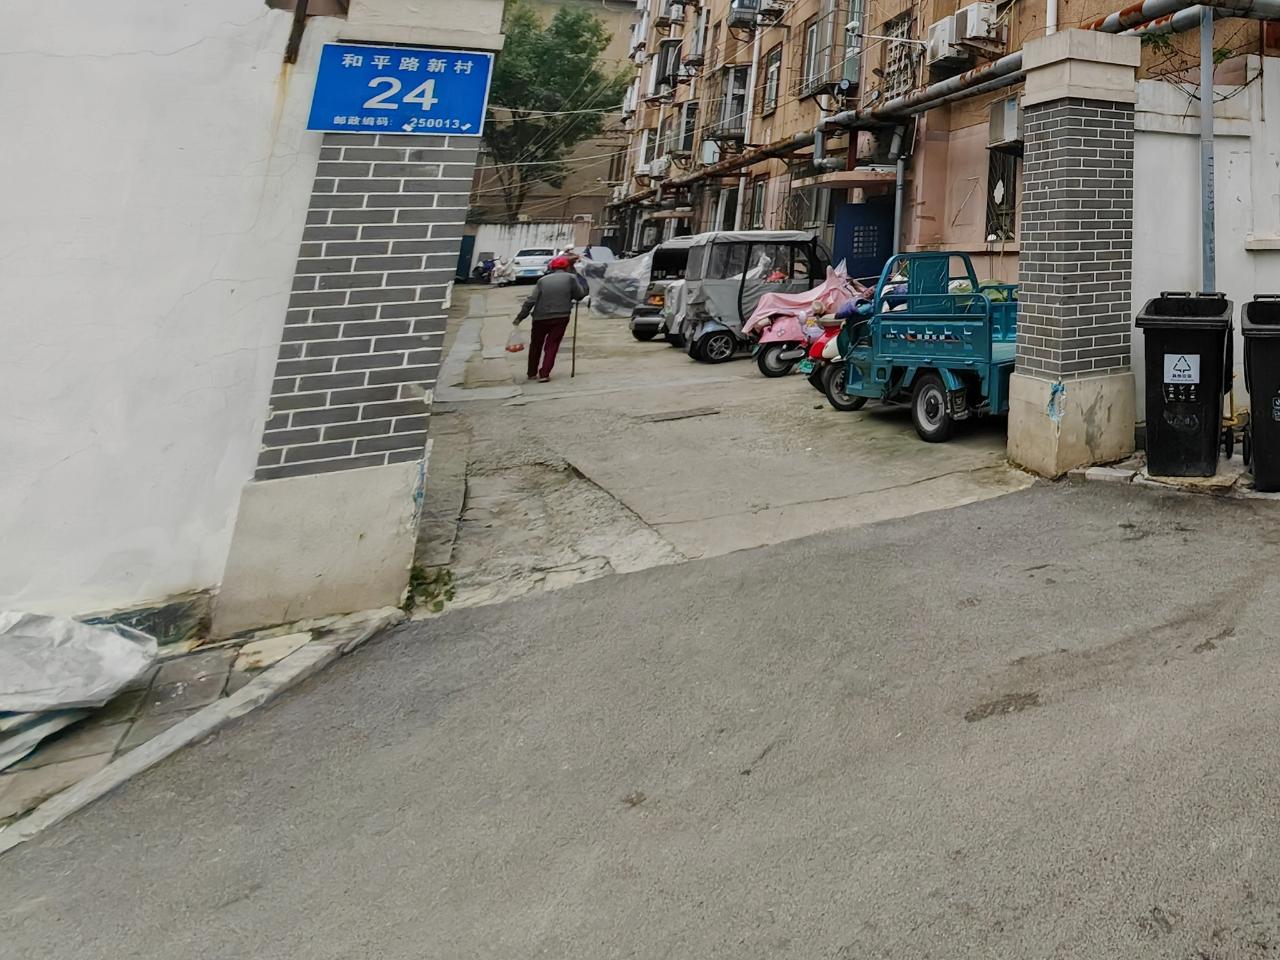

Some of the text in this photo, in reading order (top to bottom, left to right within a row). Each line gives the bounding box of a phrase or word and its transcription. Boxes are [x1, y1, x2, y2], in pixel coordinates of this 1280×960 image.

[341, 53, 474, 75] 和平路新村
[362, 76, 439, 111] 24
[409, 117, 460, 129] 250013
